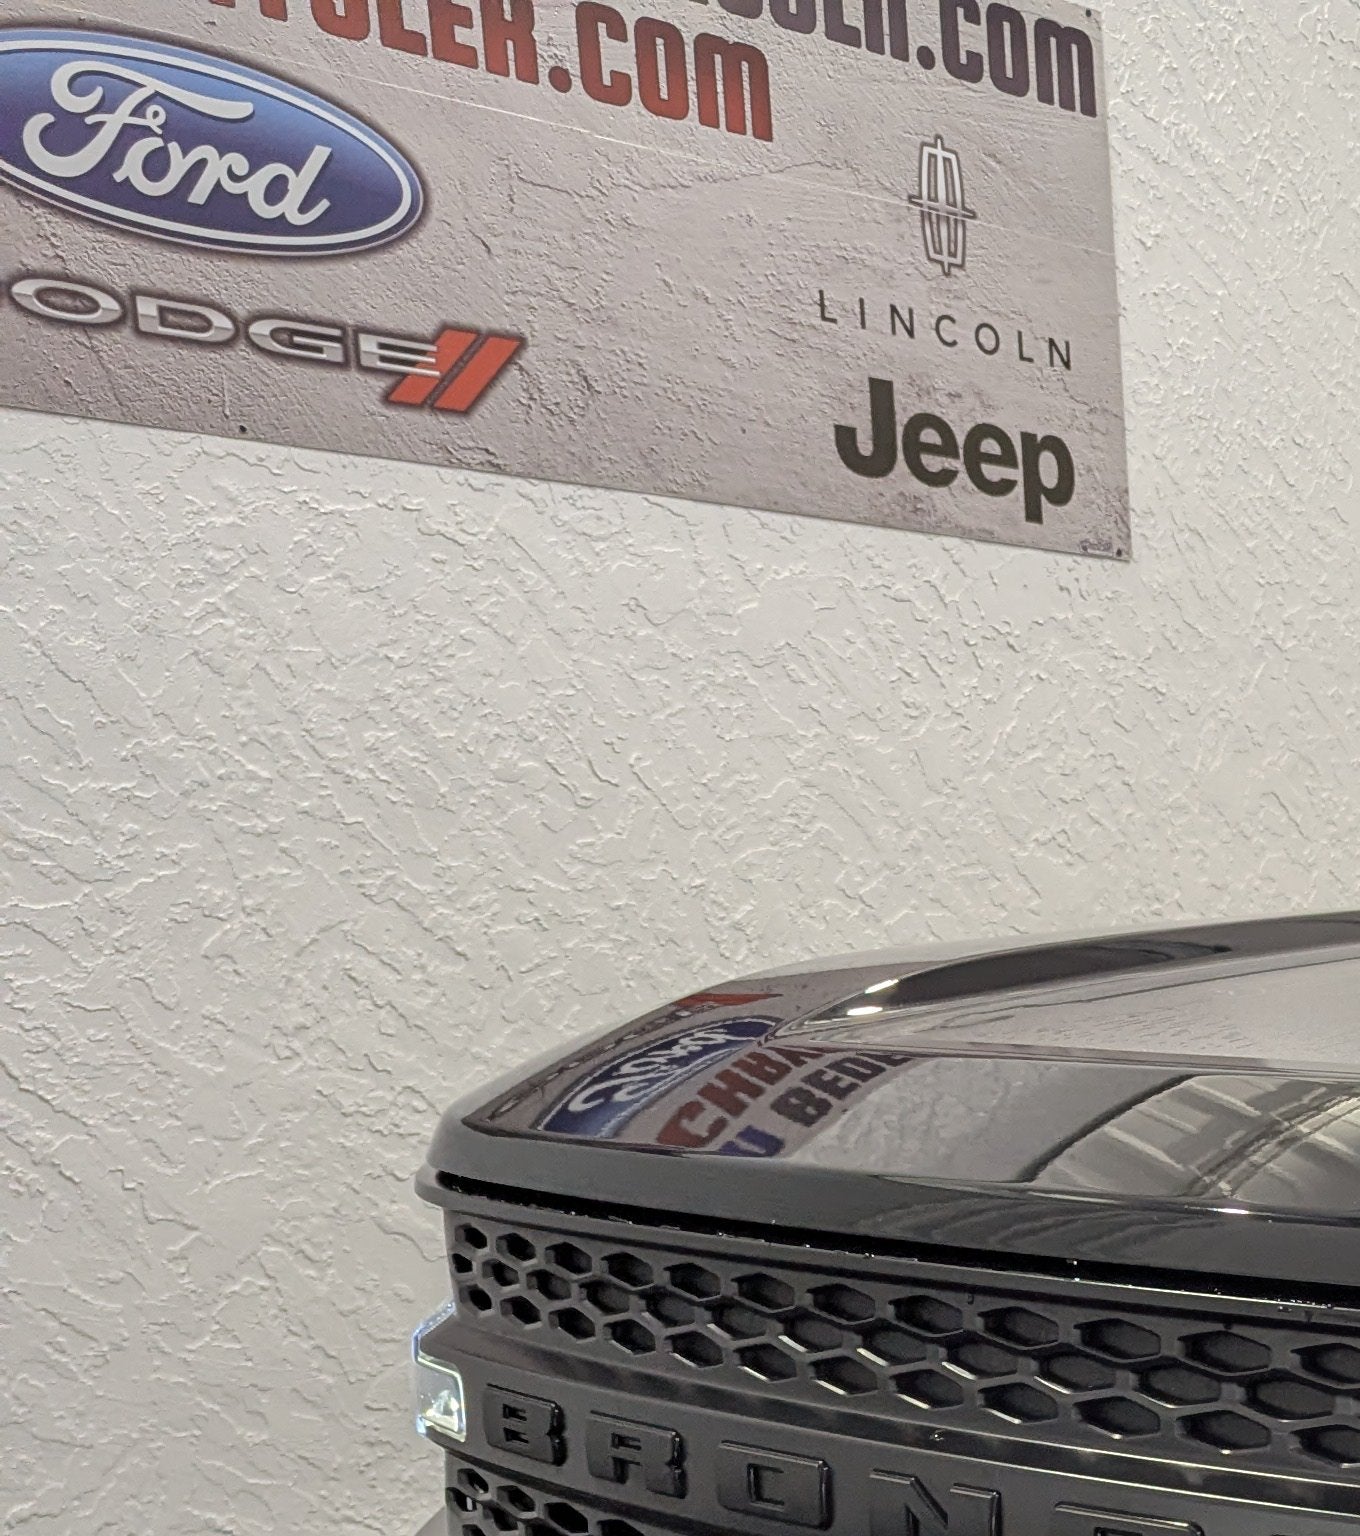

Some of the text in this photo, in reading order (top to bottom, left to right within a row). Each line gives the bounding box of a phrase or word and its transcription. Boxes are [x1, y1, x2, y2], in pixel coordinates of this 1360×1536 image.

[22, 60, 332, 226] Ford
[818, 289, 1072, 371] LINCOLN
[833, 376, 1076, 525] Jeep
